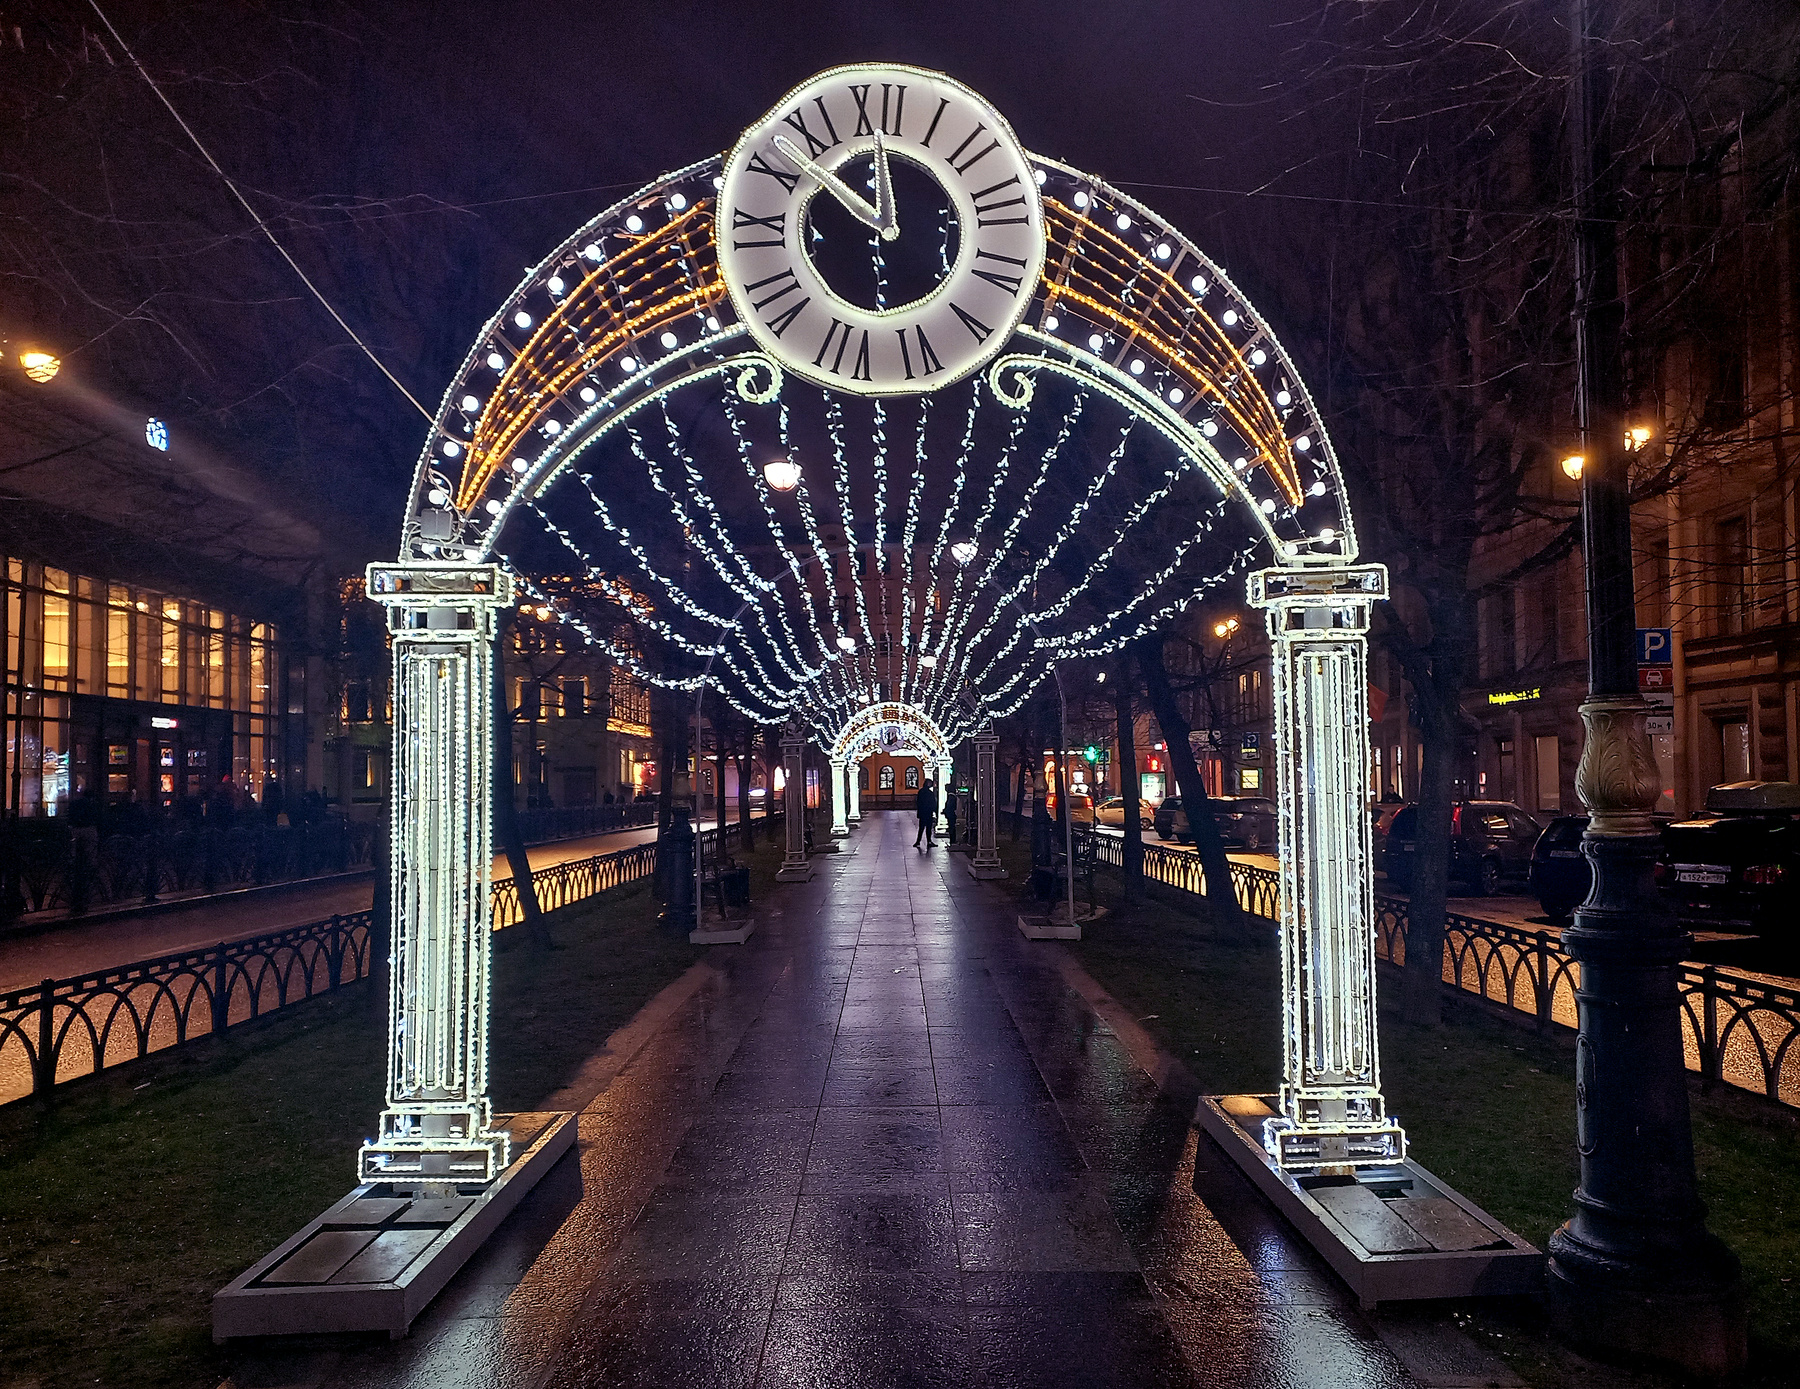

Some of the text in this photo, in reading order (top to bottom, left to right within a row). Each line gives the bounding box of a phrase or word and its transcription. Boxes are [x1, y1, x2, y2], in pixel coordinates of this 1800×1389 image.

[782, 95, 842, 159] XI
[848, 83, 907, 137] XII
[920, 97, 950, 148] I
[745, 151, 801, 195] X
[944, 122, 1002, 176] II
[970, 174, 1029, 229] III
[733, 207, 785, 250] IX
[972, 247, 1028, 298] IV
[812, 317, 872, 381] VII
[949, 302, 995, 346] V
[895, 324, 945, 380] VI
[1644, 632, 1665, 660] P
